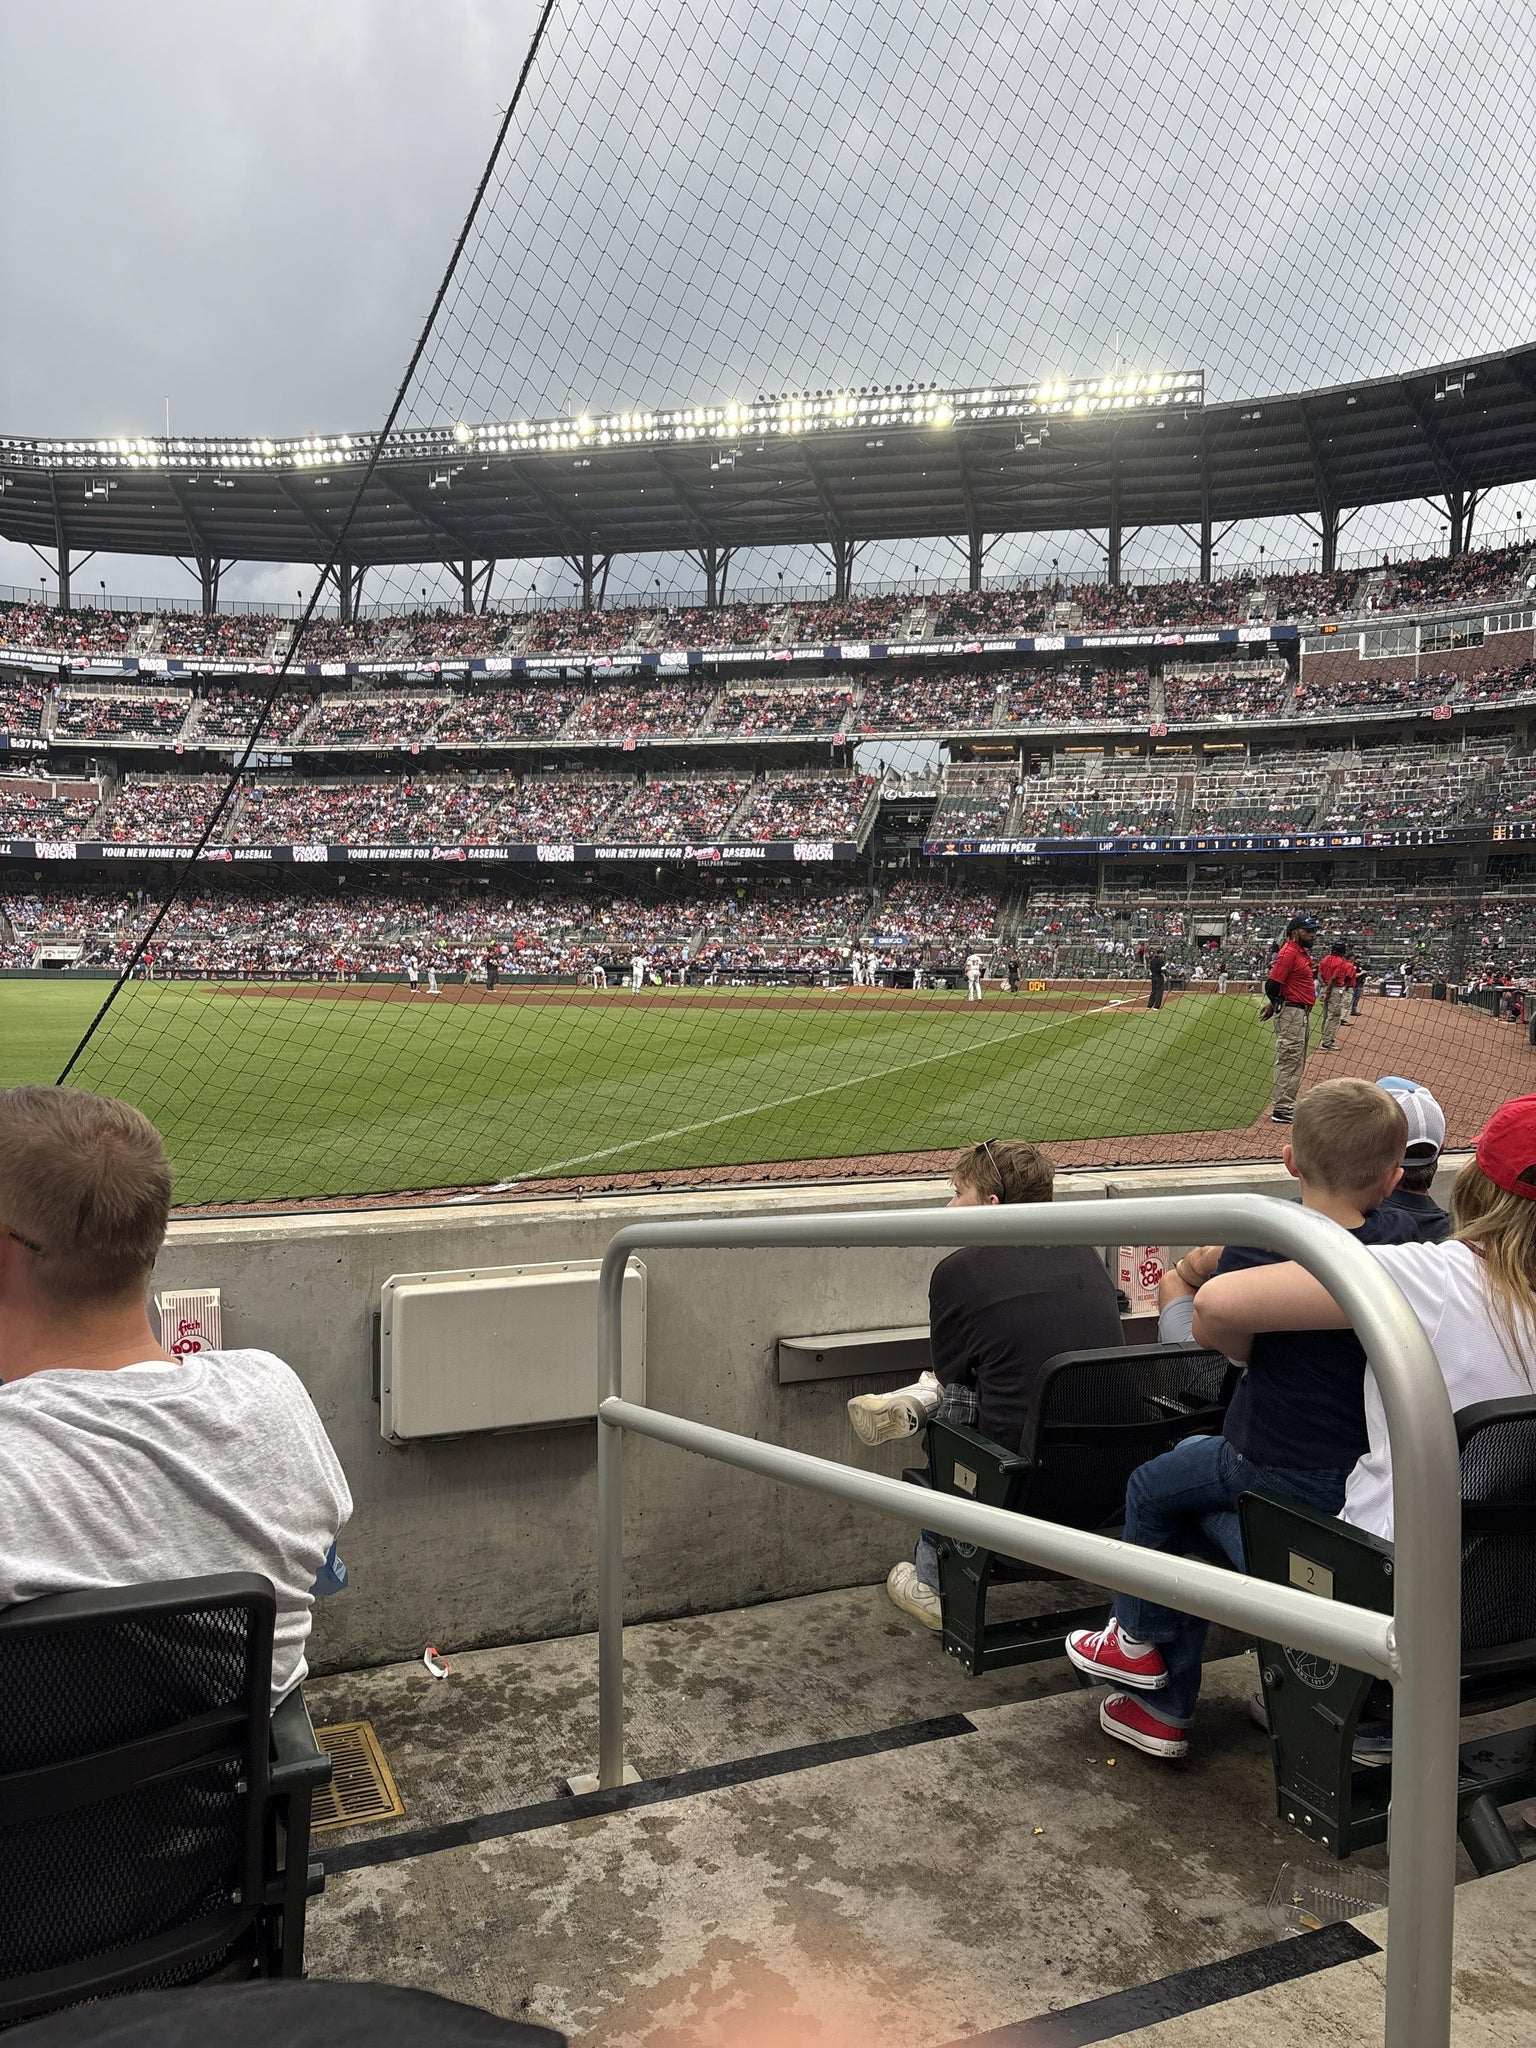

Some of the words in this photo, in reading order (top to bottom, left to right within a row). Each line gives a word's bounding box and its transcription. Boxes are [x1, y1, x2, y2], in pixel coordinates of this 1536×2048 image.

[1433, 705, 1451, 720] 29
[1150, 724, 1167, 736] 25
[32, 740, 47, 750] PM
[175, 742, 183, 754] 3
[622, 739, 636, 751] 10
[293, 845, 328, 853] BRAVES
[793, 843, 833, 851] BRAVES
[963, 844, 972, 852] 33
[979, 842, 1011, 853] MARTÍN
[1011, 842, 1036, 852] PÉREZ
[1099, 842, 1114, 851] LHP
[1143, 842, 1157, 850] 4.0
[1246, 840, 1253, 848] 2
[1278, 838, 1289, 847] 70
[1309, 838, 1325, 846] 2-2
[35, 850, 76, 859] VISION
[102, 847, 127, 857] YOUR
[127, 848, 149, 858] NEW
[150, 848, 175, 858] HOME
[176, 849, 193, 859] FOR
[234, 849, 272, 860] BASEBALL
[293, 853, 328, 862] VISION
[347, 849, 368, 859] YOUR
[369, 849, 388, 859] NEW
[389, 849, 413, 859] HOME
[414, 849, 430, 859] FOR
[468, 849, 509, 859] BASEBALL
[537, 852, 575, 862] VISION
[594, 848, 617, 858] YOUR
[618, 848, 637, 859] NEW
[638, 848, 664, 858] HOME
[664, 847, 682, 858] FOR
[722, 847, 766, 858] BASEBALL
[793, 851, 833, 860] VISION
[1029, 981, 1045, 991] 004
[1140, 1261, 1157, 1276] POP
[1142, 1269, 1163, 1287] CORN
[179, 1320, 201, 1336] fresh
[1307, 1567, 1315, 1585] 2
